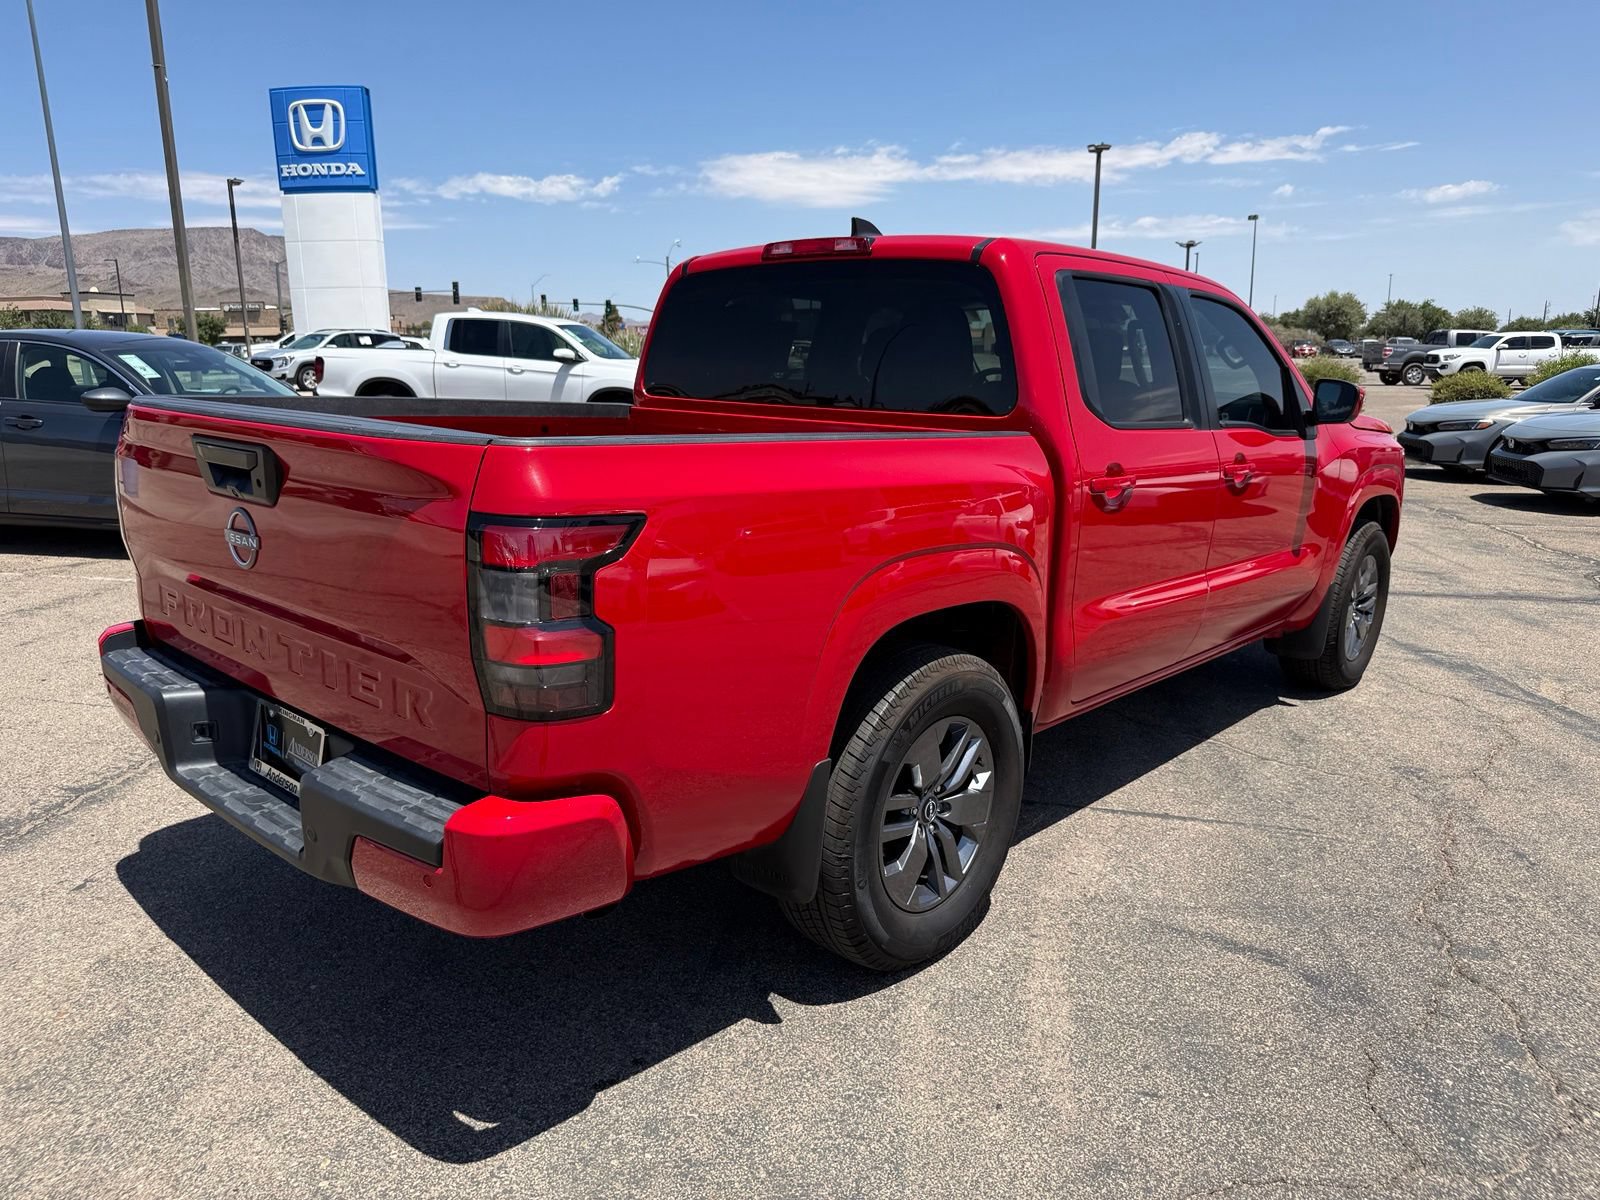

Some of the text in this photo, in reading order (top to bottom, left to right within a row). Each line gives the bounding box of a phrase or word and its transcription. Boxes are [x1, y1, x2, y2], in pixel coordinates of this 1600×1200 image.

[281, 162, 366, 177] HONDA
[159, 583, 433, 729] FRONTIER
[265, 767, 298, 794] Anderson
